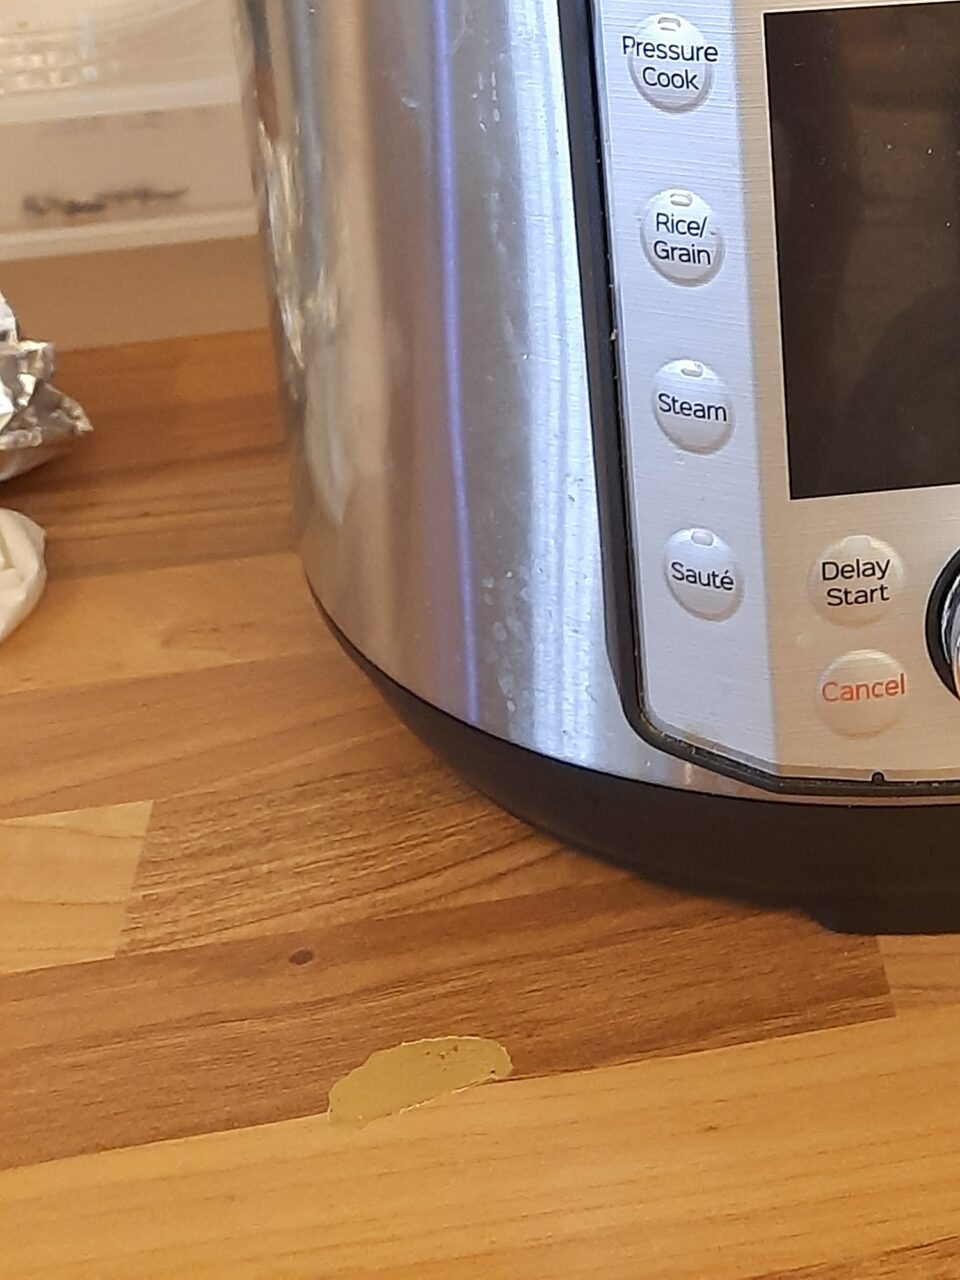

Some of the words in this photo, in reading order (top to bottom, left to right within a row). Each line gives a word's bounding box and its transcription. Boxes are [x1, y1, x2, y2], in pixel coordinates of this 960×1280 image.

[622, 36, 718, 62] Pressure
[642, 66, 700, 90] Cook
[656, 213, 707, 238] Rice/
[653, 240, 712, 266] Grain
[658, 393, 727, 421] Steam
[671, 562, 734, 590] Sauté
[821, 557, 891, 582] Delay
[826, 583, 890, 608] Start
[821, 673, 906, 703] Cancel
